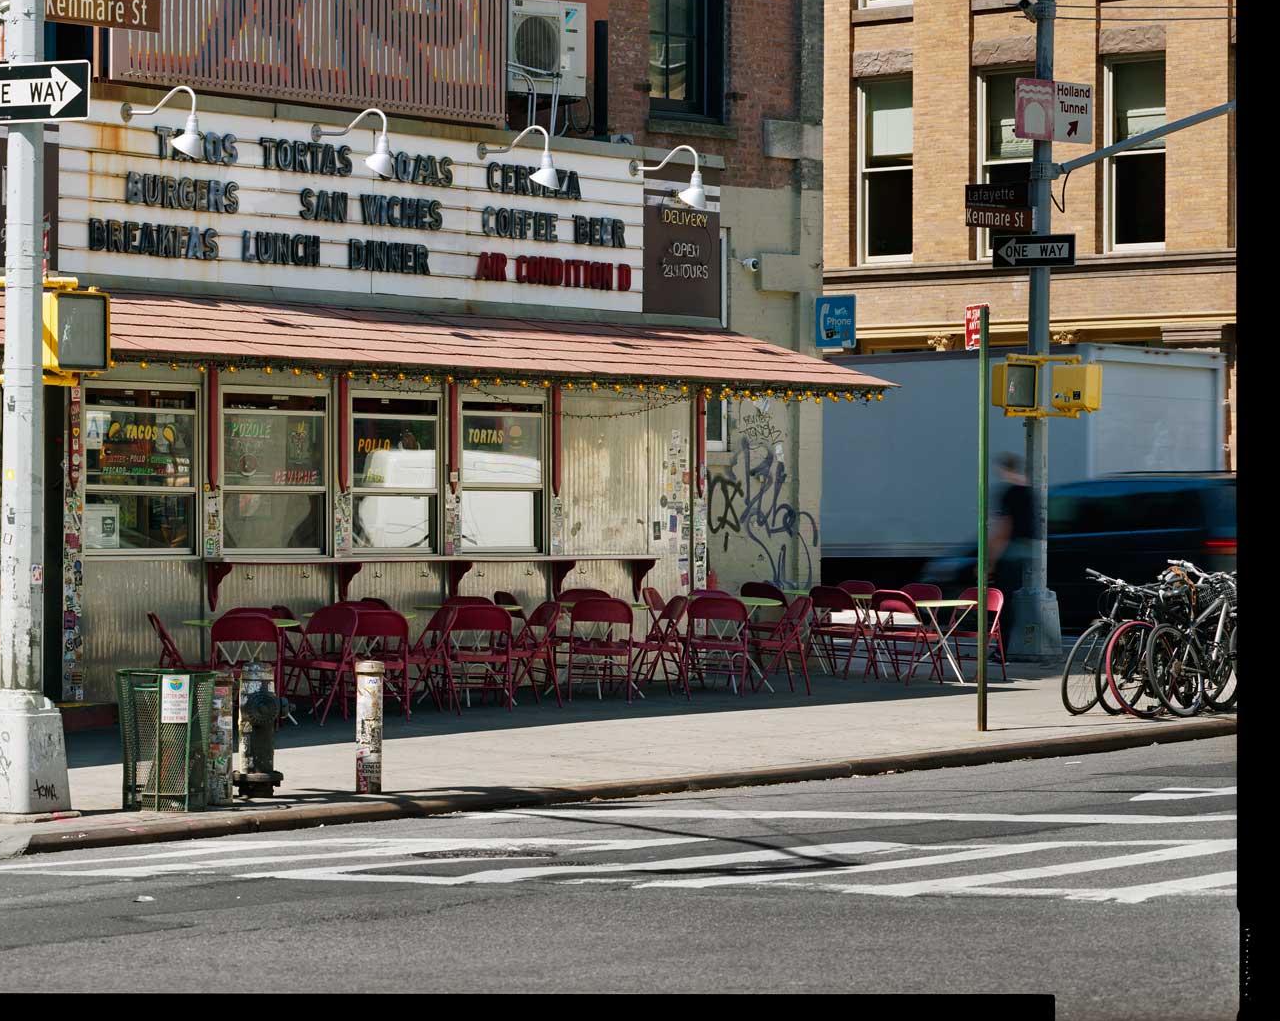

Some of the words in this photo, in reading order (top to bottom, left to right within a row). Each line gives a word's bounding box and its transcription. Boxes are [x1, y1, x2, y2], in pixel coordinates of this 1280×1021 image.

[30, 80, 69, 103] WAY
[1057, 84, 1091, 99] Holland
[1058, 101, 1089, 115] Tunnel
[259, 136, 353, 177] TORTAS
[380, 150, 454, 188] OPAS
[125, 170, 240, 214] BURGERS
[968, 187, 1015, 205] Lafayette
[299, 187, 348, 224] SAN
[359, 193, 443, 231] WICHES
[664, 209, 709, 228] DELIVERY
[966, 207, 1010, 227] Kenmare
[1014, 211, 1024, 228] St
[481, 205, 559, 242] COFFEE
[575, 214, 626, 248] BEER
[88, 218, 219, 260] BREAKFAS
[241, 230, 321, 267] LUNCH
[348, 238, 430, 276] DINNER
[672, 242, 701, 258] OPEN
[1005, 245, 1029, 258] ONE
[1039, 244, 1065, 257] WAY
[474, 251, 508, 281] AIR
[826, 316, 852, 326] Phone
[125, 424, 158, 440] TACOS
[231, 421, 272, 439] POZOLE
[467, 427, 504, 445] TORTAS
[357, 438, 391, 453] POLLO
[273, 468, 318, 484] CEVICHE
